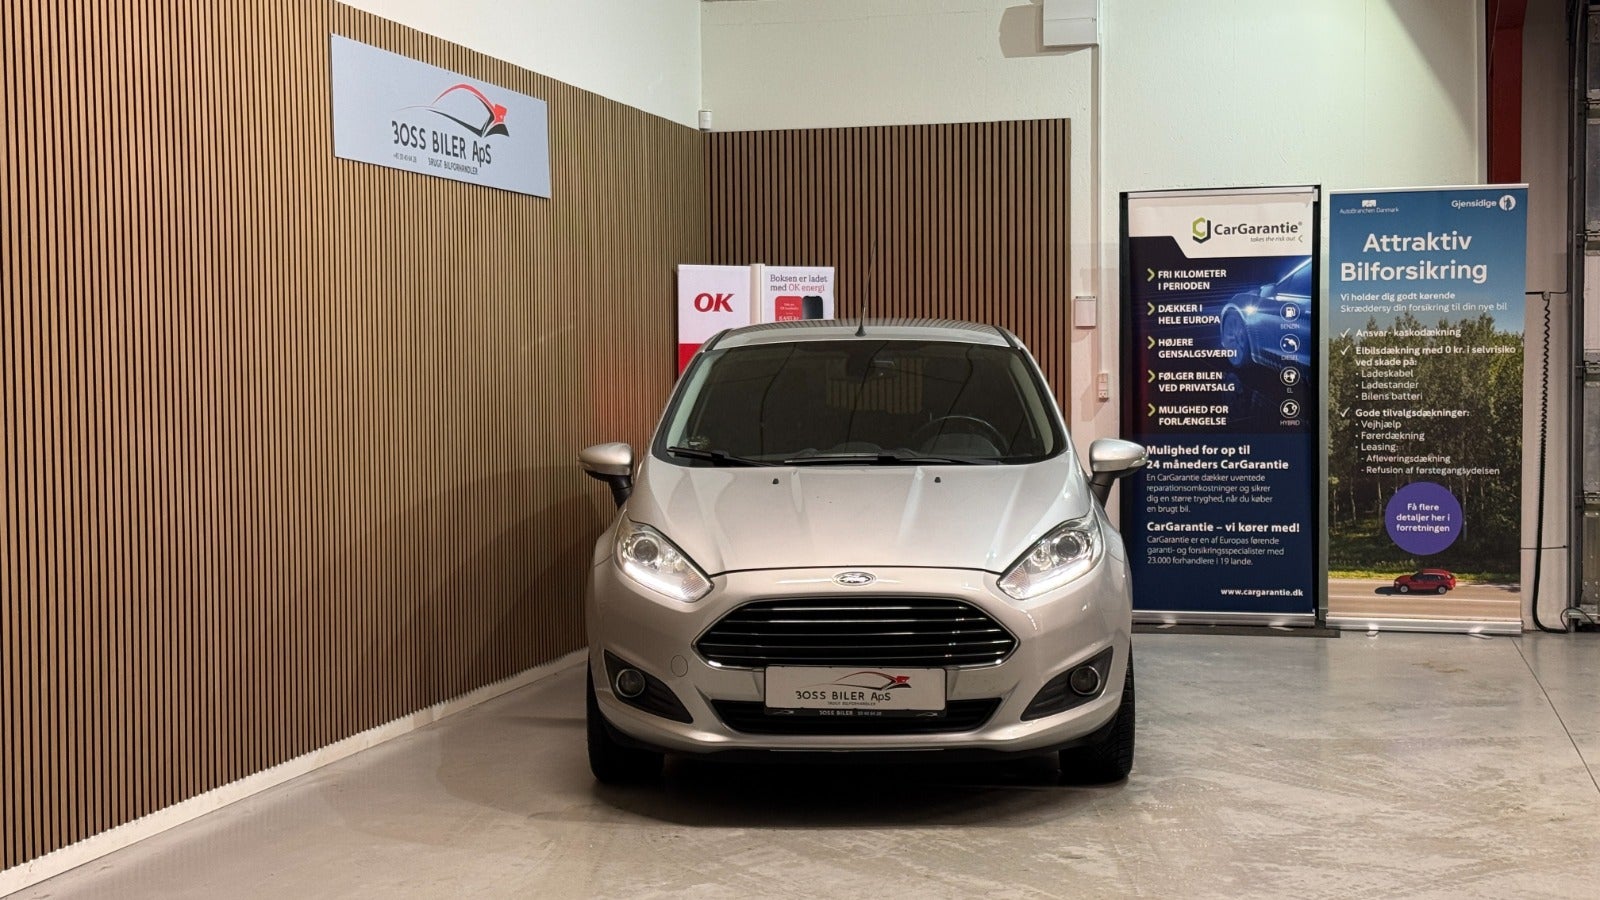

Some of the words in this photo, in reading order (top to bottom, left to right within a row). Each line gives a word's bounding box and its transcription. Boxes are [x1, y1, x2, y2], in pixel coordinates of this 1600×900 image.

[432, 130, 466, 159] BILER
[472, 141, 491, 168] ApS
[1451, 199, 1497, 208] Gjensidige
[1363, 231, 1472, 252] Attraktiv
[1158, 270, 1172, 278] FRI
[1174, 270, 1227, 278] KILOMETER
[1341, 260, 1487, 284] Bilforsikring
[770, 274, 797, 282] Boksen
[802, 284, 825, 293] energi
[1158, 282, 1161, 290] I
[1163, 282, 1210, 290] PERIODEN
[1341, 293, 1350, 301] Vi
[1351, 293, 1379, 301] holder
[1381, 293, 1394, 302] dig
[1397, 292, 1417, 301] godt
[1419, 292, 1455, 300] kørende
[694, 293, 734, 312] OK
[1158, 305, 1197, 313] DÆKKER
[1200, 304, 1202, 312] I
[1340, 304, 1391, 314] Skræddersy
[1393, 304, 1406, 312] din
[1408, 303, 1449, 312] forsikring
[1451, 303, 1461, 311] til
[1478, 304, 1494, 312] nye
[1496, 302, 1507, 310] bil
[1158, 316, 1181, 324] HELE
[1183, 316, 1220, 324] EUROPA
[1356, 329, 1392, 337] Ansvar-
[1394, 329, 1461, 337] kaskodækning
[1158, 338, 1193, 346] HØJERE
[1158, 349, 1237, 358] GENSALGSVÆRDI
[1356, 347, 1420, 356] Elbilsdækning
[1422, 346, 1443, 354] med
[1445, 346, 1451, 354] 0
[1453, 346, 1465, 354] kr.
[1356, 358, 1372, 366] ved
[1374, 358, 1401, 366] skade
[1403, 357, 1417, 367] på:
[1158, 372, 1194, 380] FØLGER
[1362, 370, 1413, 378] Ladeskabel
[1159, 384, 1177, 392] VED
[1180, 384, 1235, 392] PRIVATSALG
[1362, 381, 1418, 389] Ladestander
[1159, 406, 1208, 414] MULIGHED
[1210, 405, 1229, 414] FOR
[1383, 409, 1470, 418] tilvalgsdækninger:
[1159, 417, 1226, 426] FORLÆNGELSE
[1361, 421, 1401, 430] Vejhjælp
[1361, 432, 1425, 441] Førerdækning
[1146, 445, 1199, 457] Mulighed
[1202, 445, 1218, 454] for
[1221, 447, 1235, 457] op
[1239, 445, 1250, 454] til
[1146, 460, 1160, 469] 24
[1163, 459, 1217, 469] måneders
[1220, 460, 1289, 469] CarGarantie
[1367, 455, 1450, 464] Afleveringsdækning
[1416, 467, 1500, 476] førstegangsydelsen
[1147, 484, 1237, 493] reparationsomkostninger
[1251, 484, 1270, 492] sikrer
[1147, 495, 1158, 504] dig
[1193, 495, 1224, 504] tryghed,
[1158, 505, 1178, 514] brugt
[1180, 505, 1190, 513] bil.
[1396, 514, 1429, 522] detaljer
[1147, 522, 1214, 532] CarGarantie
[1225, 523, 1235, 532] vi
[1238, 523, 1268, 532] kører
[1271, 523, 1299, 532] med!
[1396, 524, 1450, 533] forretningen
[1220, 537, 1249, 546] Europas
[1189, 547, 1265, 556] forsikringsspecialister
[1172, 557, 1214, 565] forhandlere
[1221, 589, 1303, 597] www.cargarantie.dk
[832, 692, 864, 700] BILER
[871, 693, 891, 702] ApS
